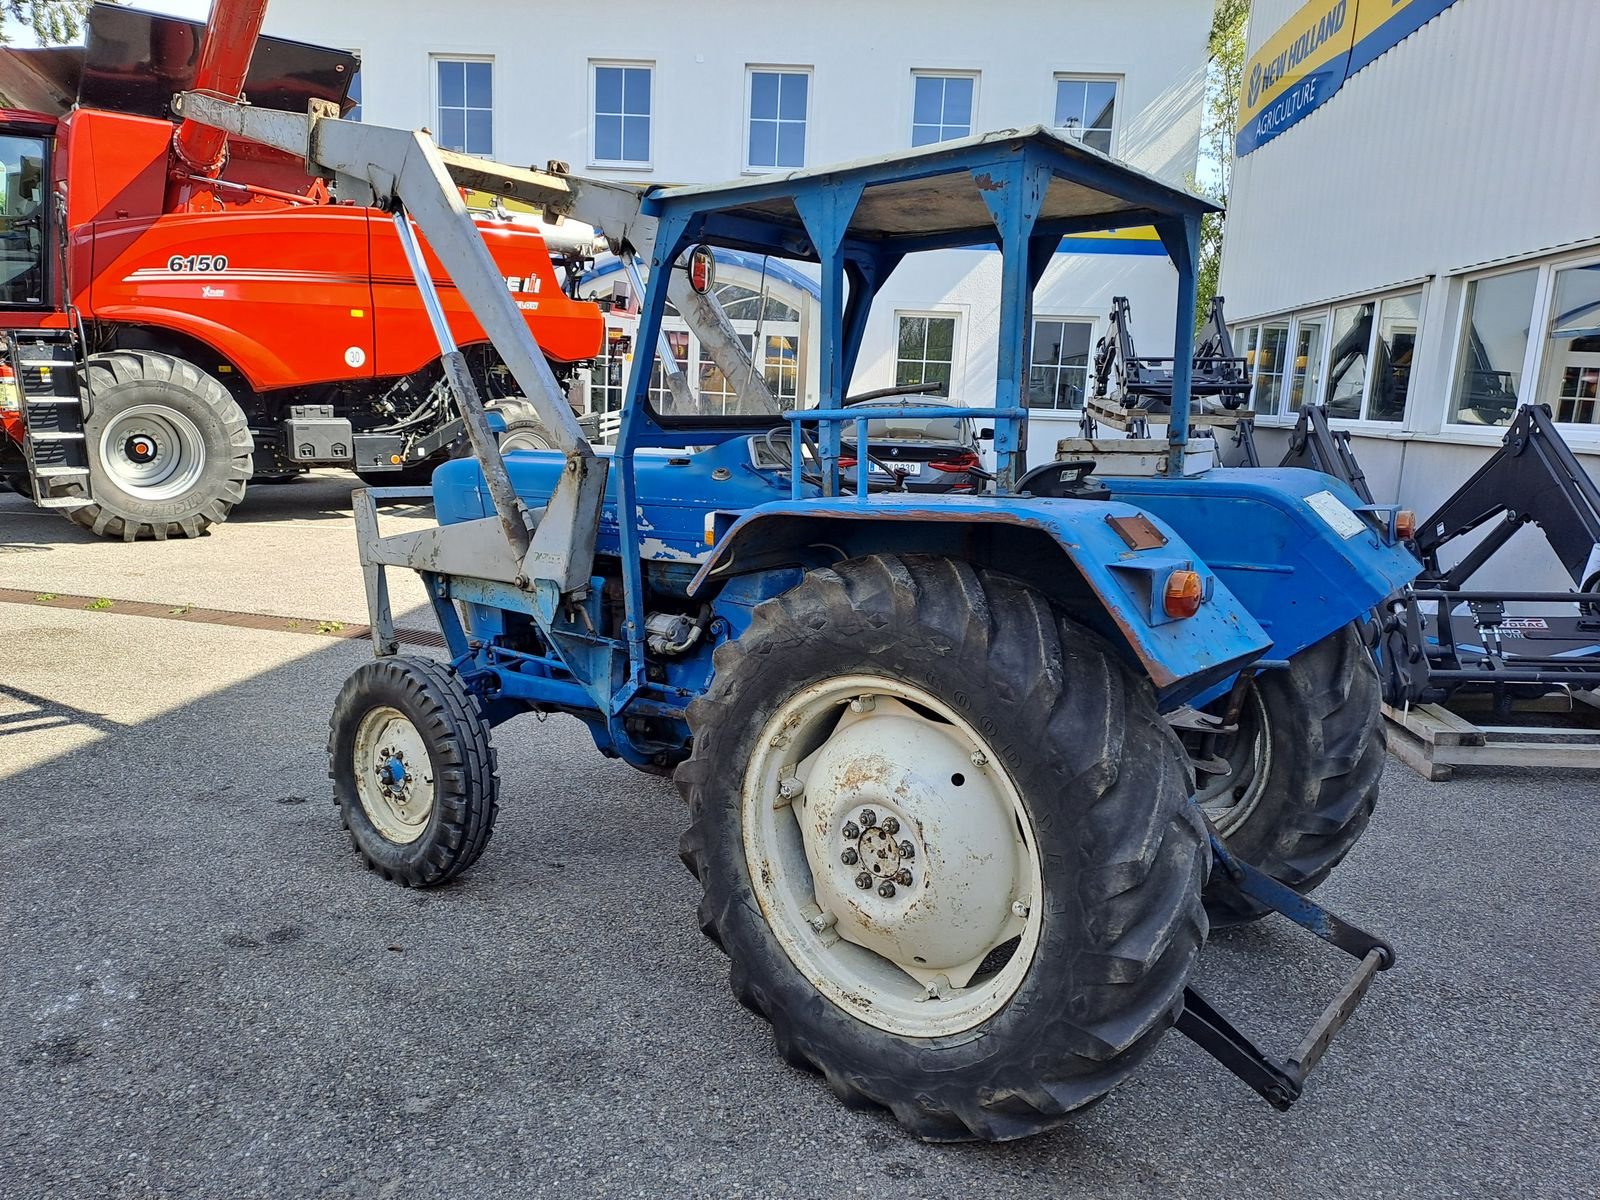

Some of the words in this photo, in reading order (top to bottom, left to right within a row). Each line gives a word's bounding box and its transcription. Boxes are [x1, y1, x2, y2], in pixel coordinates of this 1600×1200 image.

[1262, 50, 1287, 93] NEW
[1287, 0, 1346, 72] HOLLAND
[1255, 78, 1317, 139] AGRICULTURE
[168, 255, 228, 272] 6150
[350, 351, 360, 363] 30
